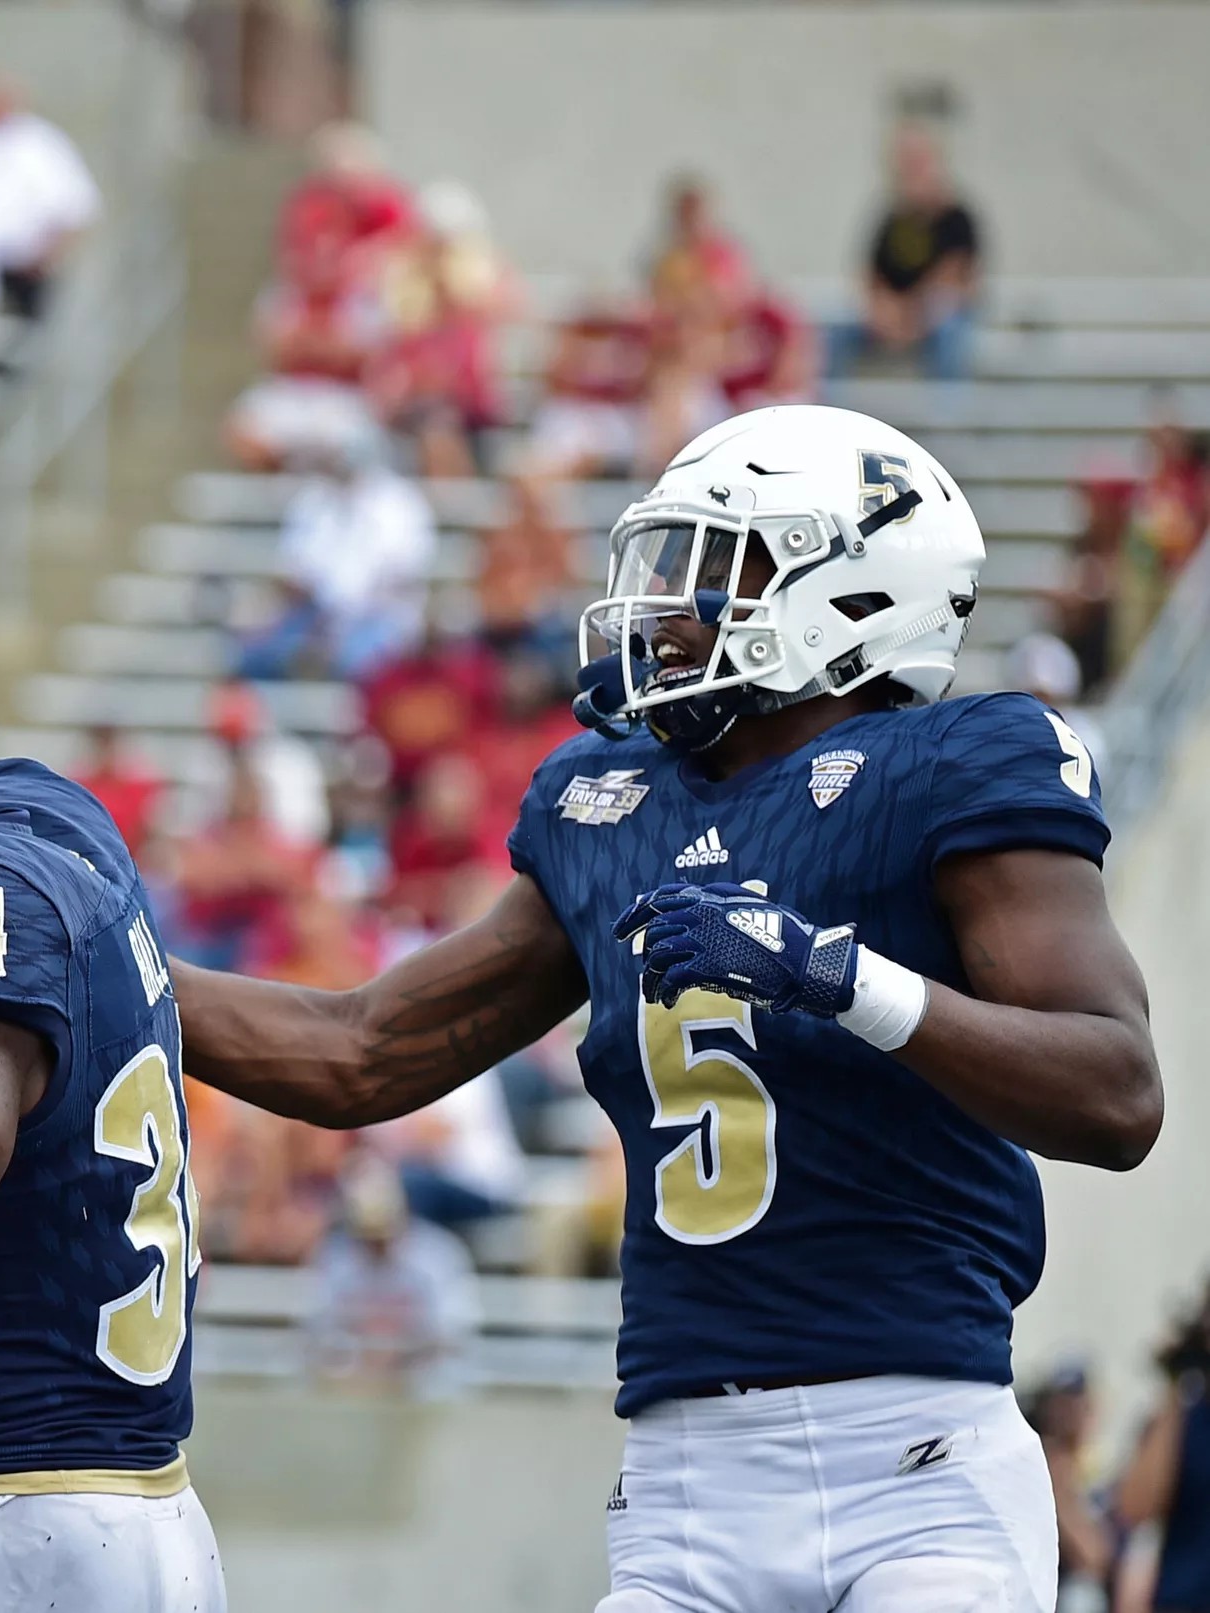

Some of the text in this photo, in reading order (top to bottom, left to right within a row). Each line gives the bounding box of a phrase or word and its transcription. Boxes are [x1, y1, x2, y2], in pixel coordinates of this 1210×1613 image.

[857, 448, 916, 525] 5
[1043, 711, 1092, 799] 5
[567, 788, 642, 808] TAYLOR 33
[807, 774, 854, 789] MAC
[674, 848, 730, 869] adidas
[727, 911, 786, 954] adidas
[633, 881, 778, 1246] 5
